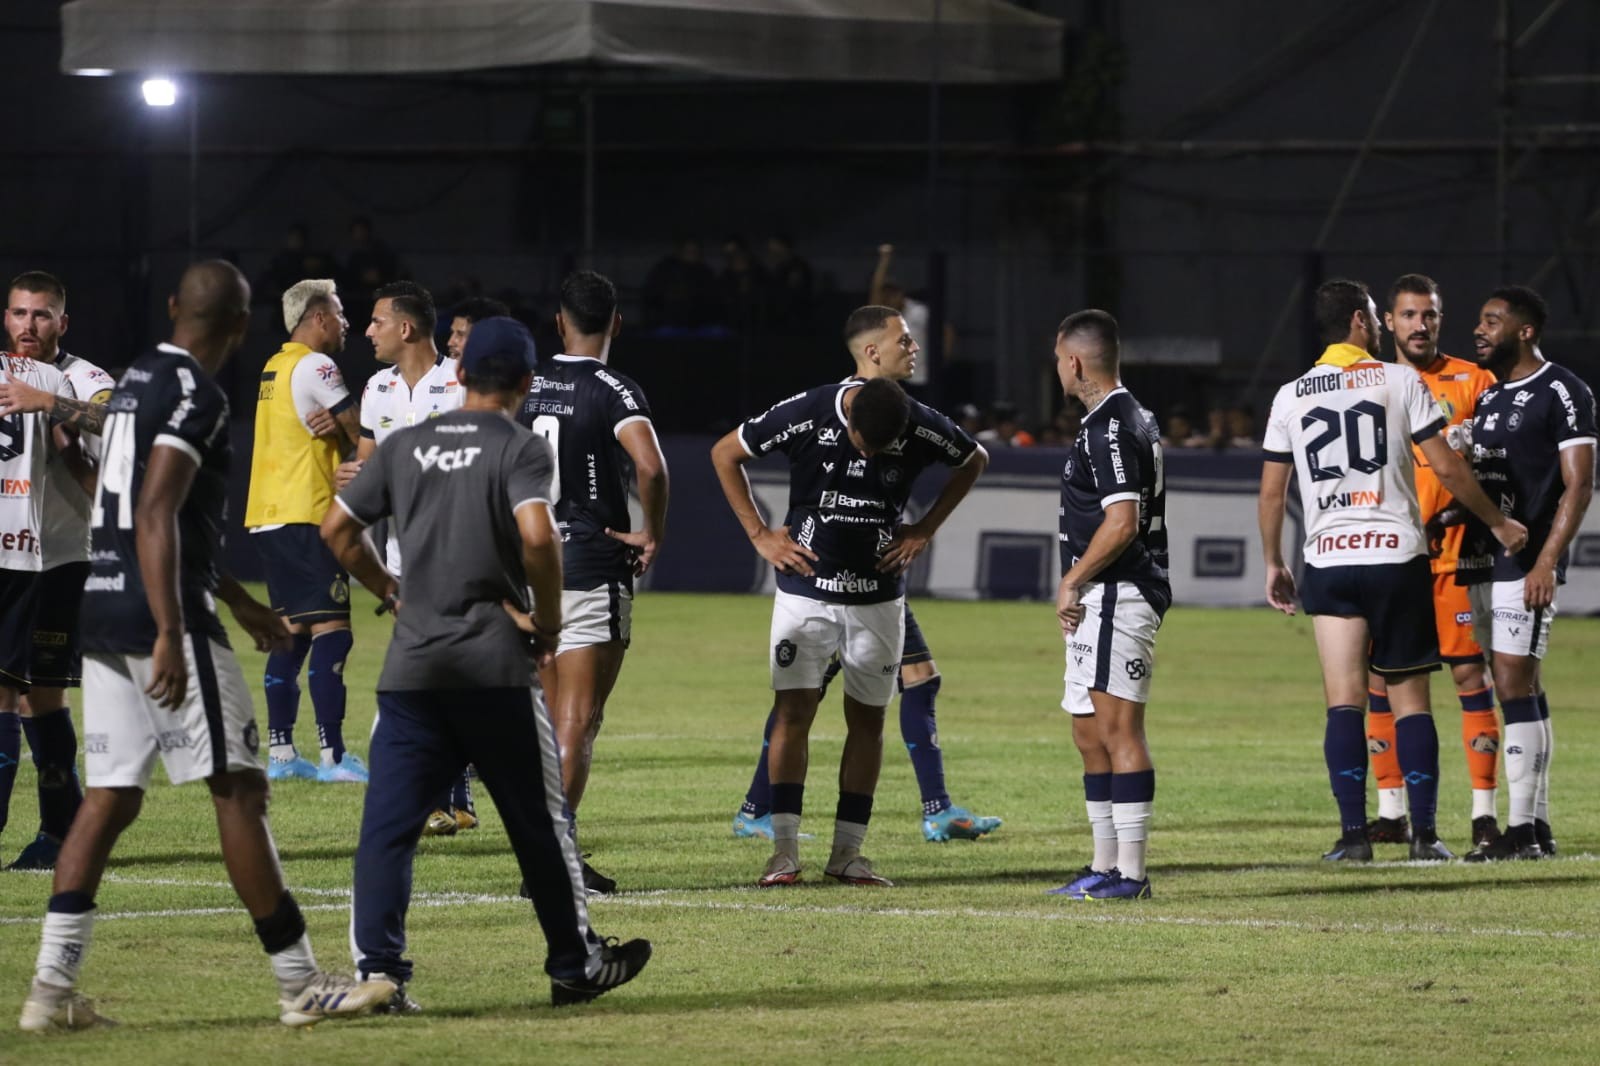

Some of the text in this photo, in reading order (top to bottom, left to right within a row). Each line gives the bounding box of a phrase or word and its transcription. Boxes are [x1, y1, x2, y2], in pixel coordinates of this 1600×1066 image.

[1301, 400, 1388, 482] 20
[587, 453, 598, 500] ESAMAZ
[1317, 491, 1385, 511] UNIFAN
[1316, 529, 1400, 556] Incefra
[814, 577, 879, 593] mirella
